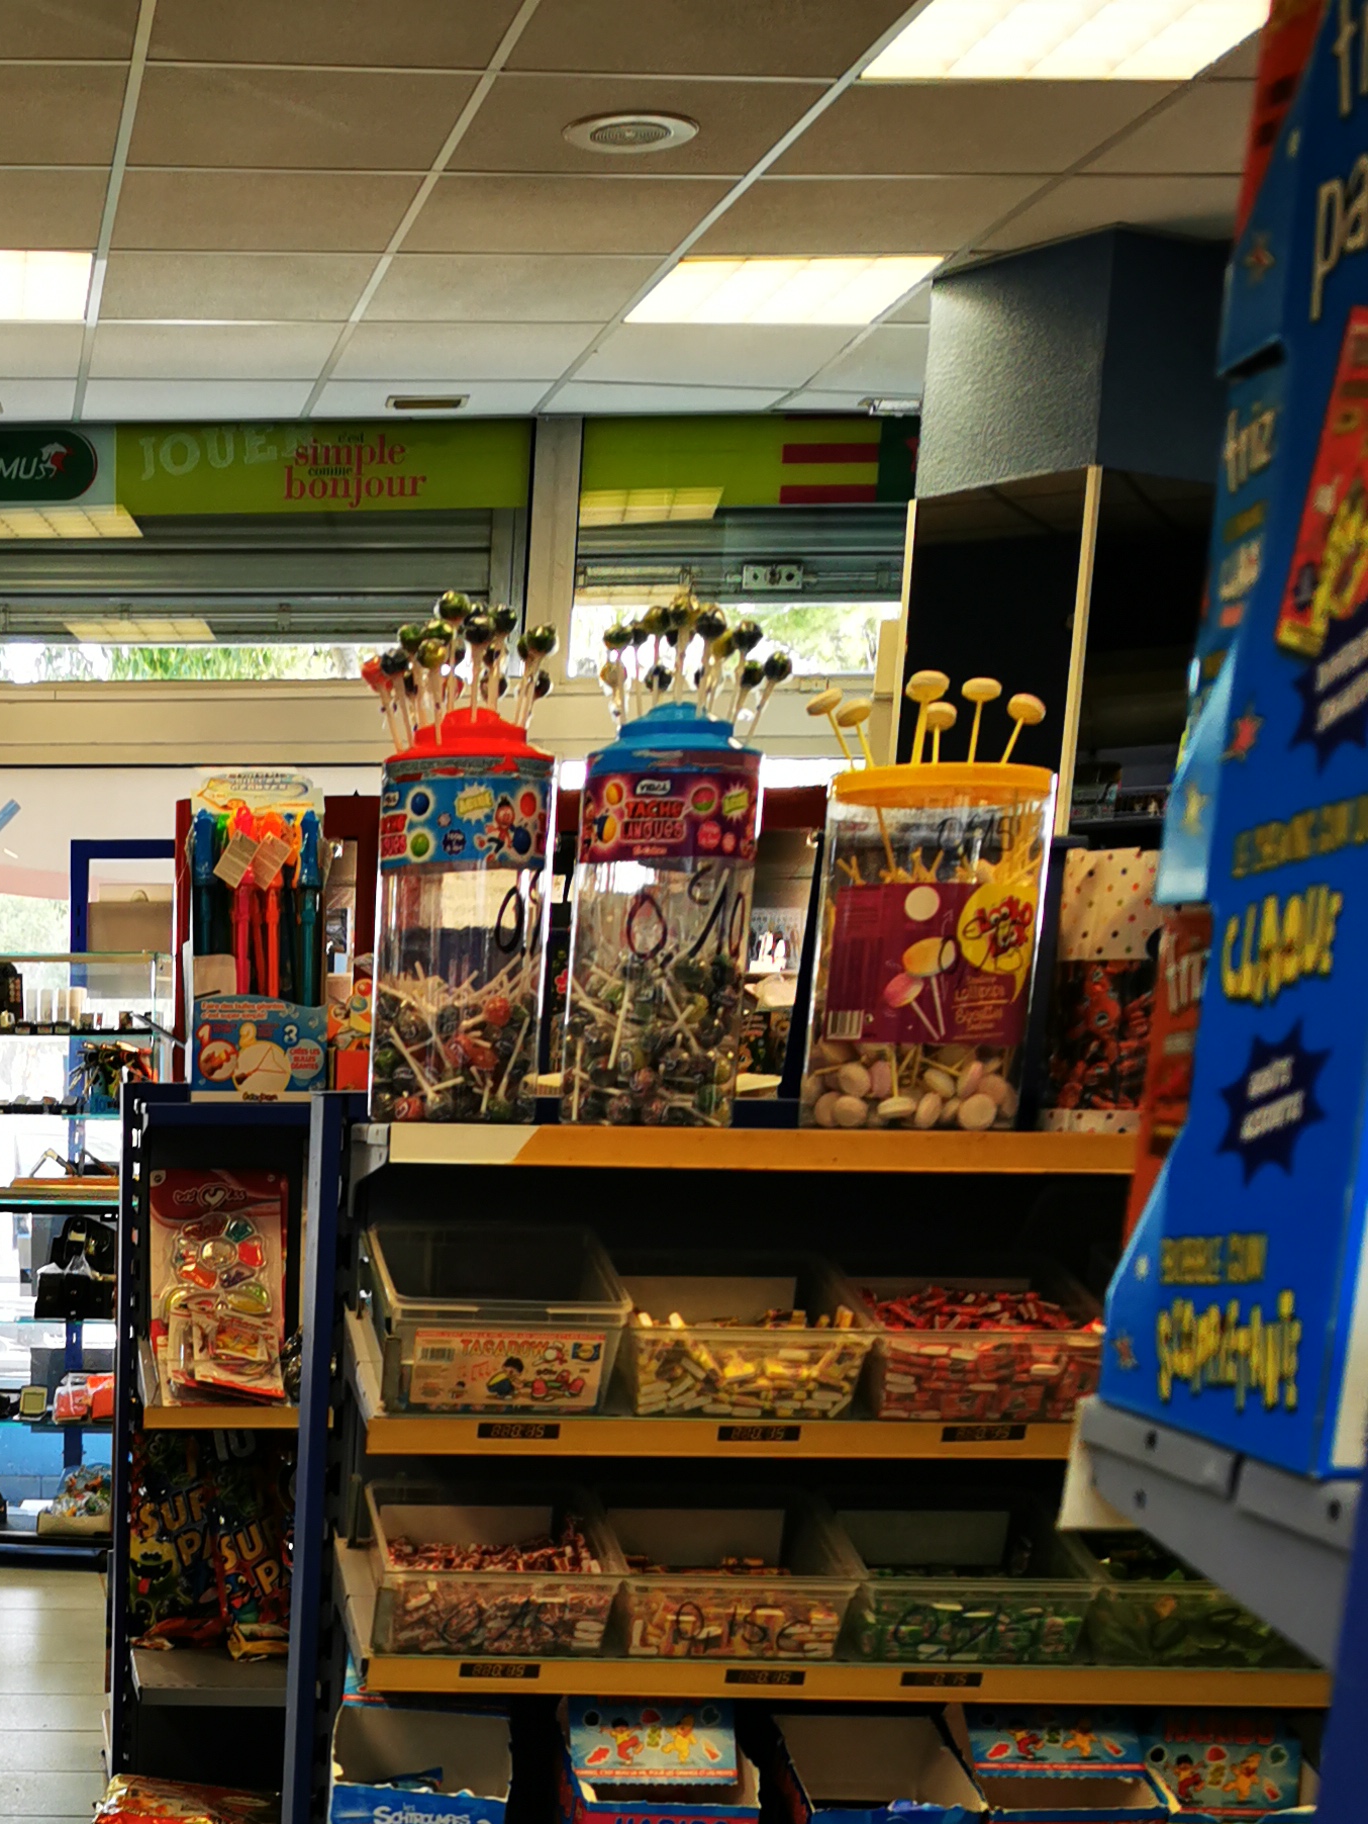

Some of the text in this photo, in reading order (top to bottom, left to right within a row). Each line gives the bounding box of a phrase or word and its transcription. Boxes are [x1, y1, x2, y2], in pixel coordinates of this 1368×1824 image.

[293, 433, 407, 476] simple
[283, 465, 427, 510] bonjour
[307, 465, 353, 478] comme
[283, 1023, 299, 1044] 3
